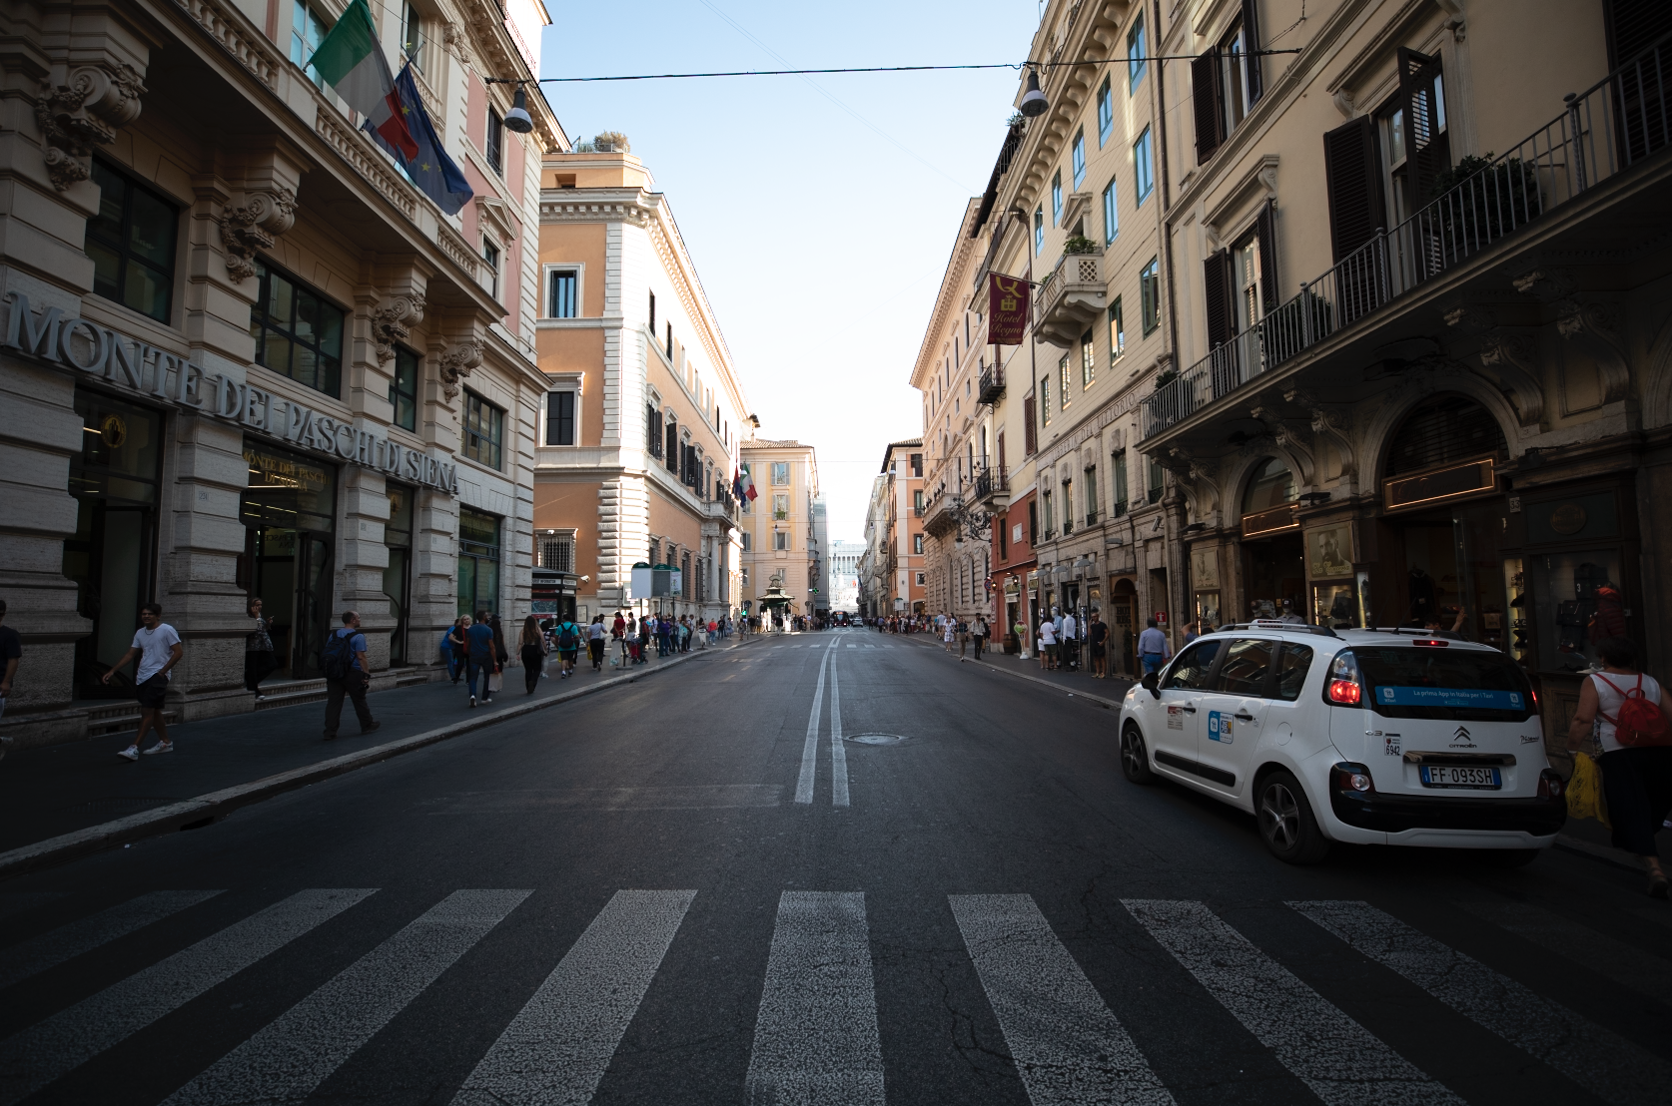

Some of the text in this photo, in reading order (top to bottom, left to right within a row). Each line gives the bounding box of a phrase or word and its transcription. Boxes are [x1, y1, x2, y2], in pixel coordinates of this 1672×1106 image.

[992, 312, 1024, 323] Hotel
[990, 323, 1022, 337] Regno
[5, 291, 460, 495] MONTE DEI PASCHI DI SIENA
[1096, 393, 1136, 429] LITTORIO
[243, 451, 331, 485] MONTE DEI PASCHI
[264, 471, 308, 492] DI SIENA
[1421, 690, 1437, 698] prima
[1438, 690, 1449, 698] App
[1386, 744, 1400, 756] 6942
